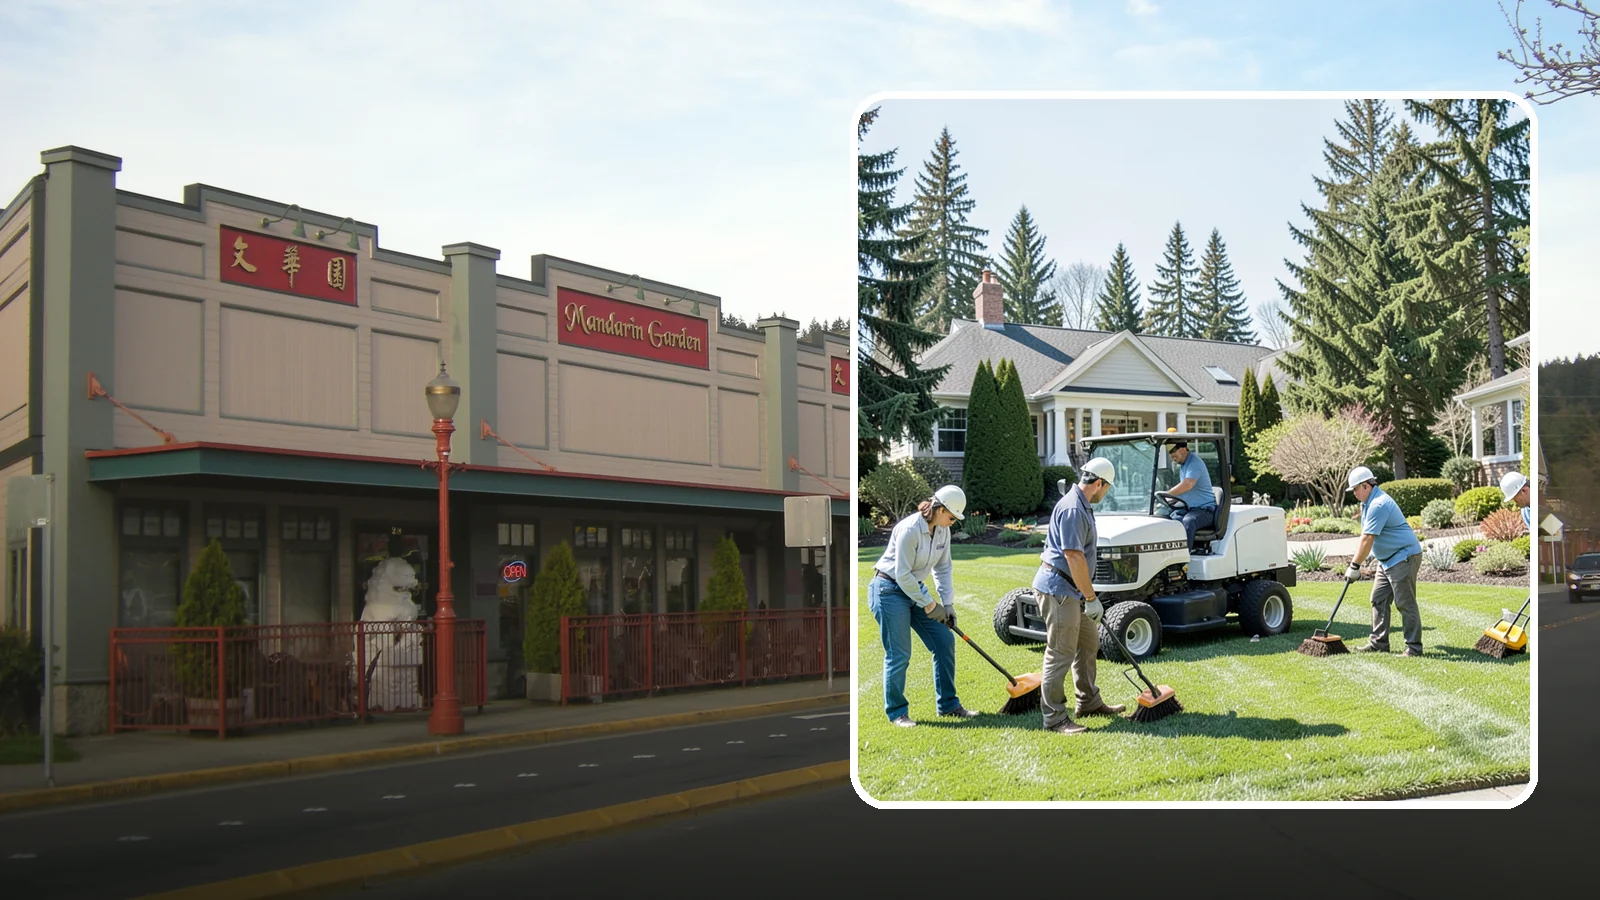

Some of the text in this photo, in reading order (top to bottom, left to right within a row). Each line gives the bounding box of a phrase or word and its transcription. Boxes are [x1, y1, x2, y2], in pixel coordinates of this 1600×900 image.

[230, 235, 346, 291] 文華園
[564, 302, 702, 352] Mandarin Garden
[503, 565, 527, 578] OPEN
